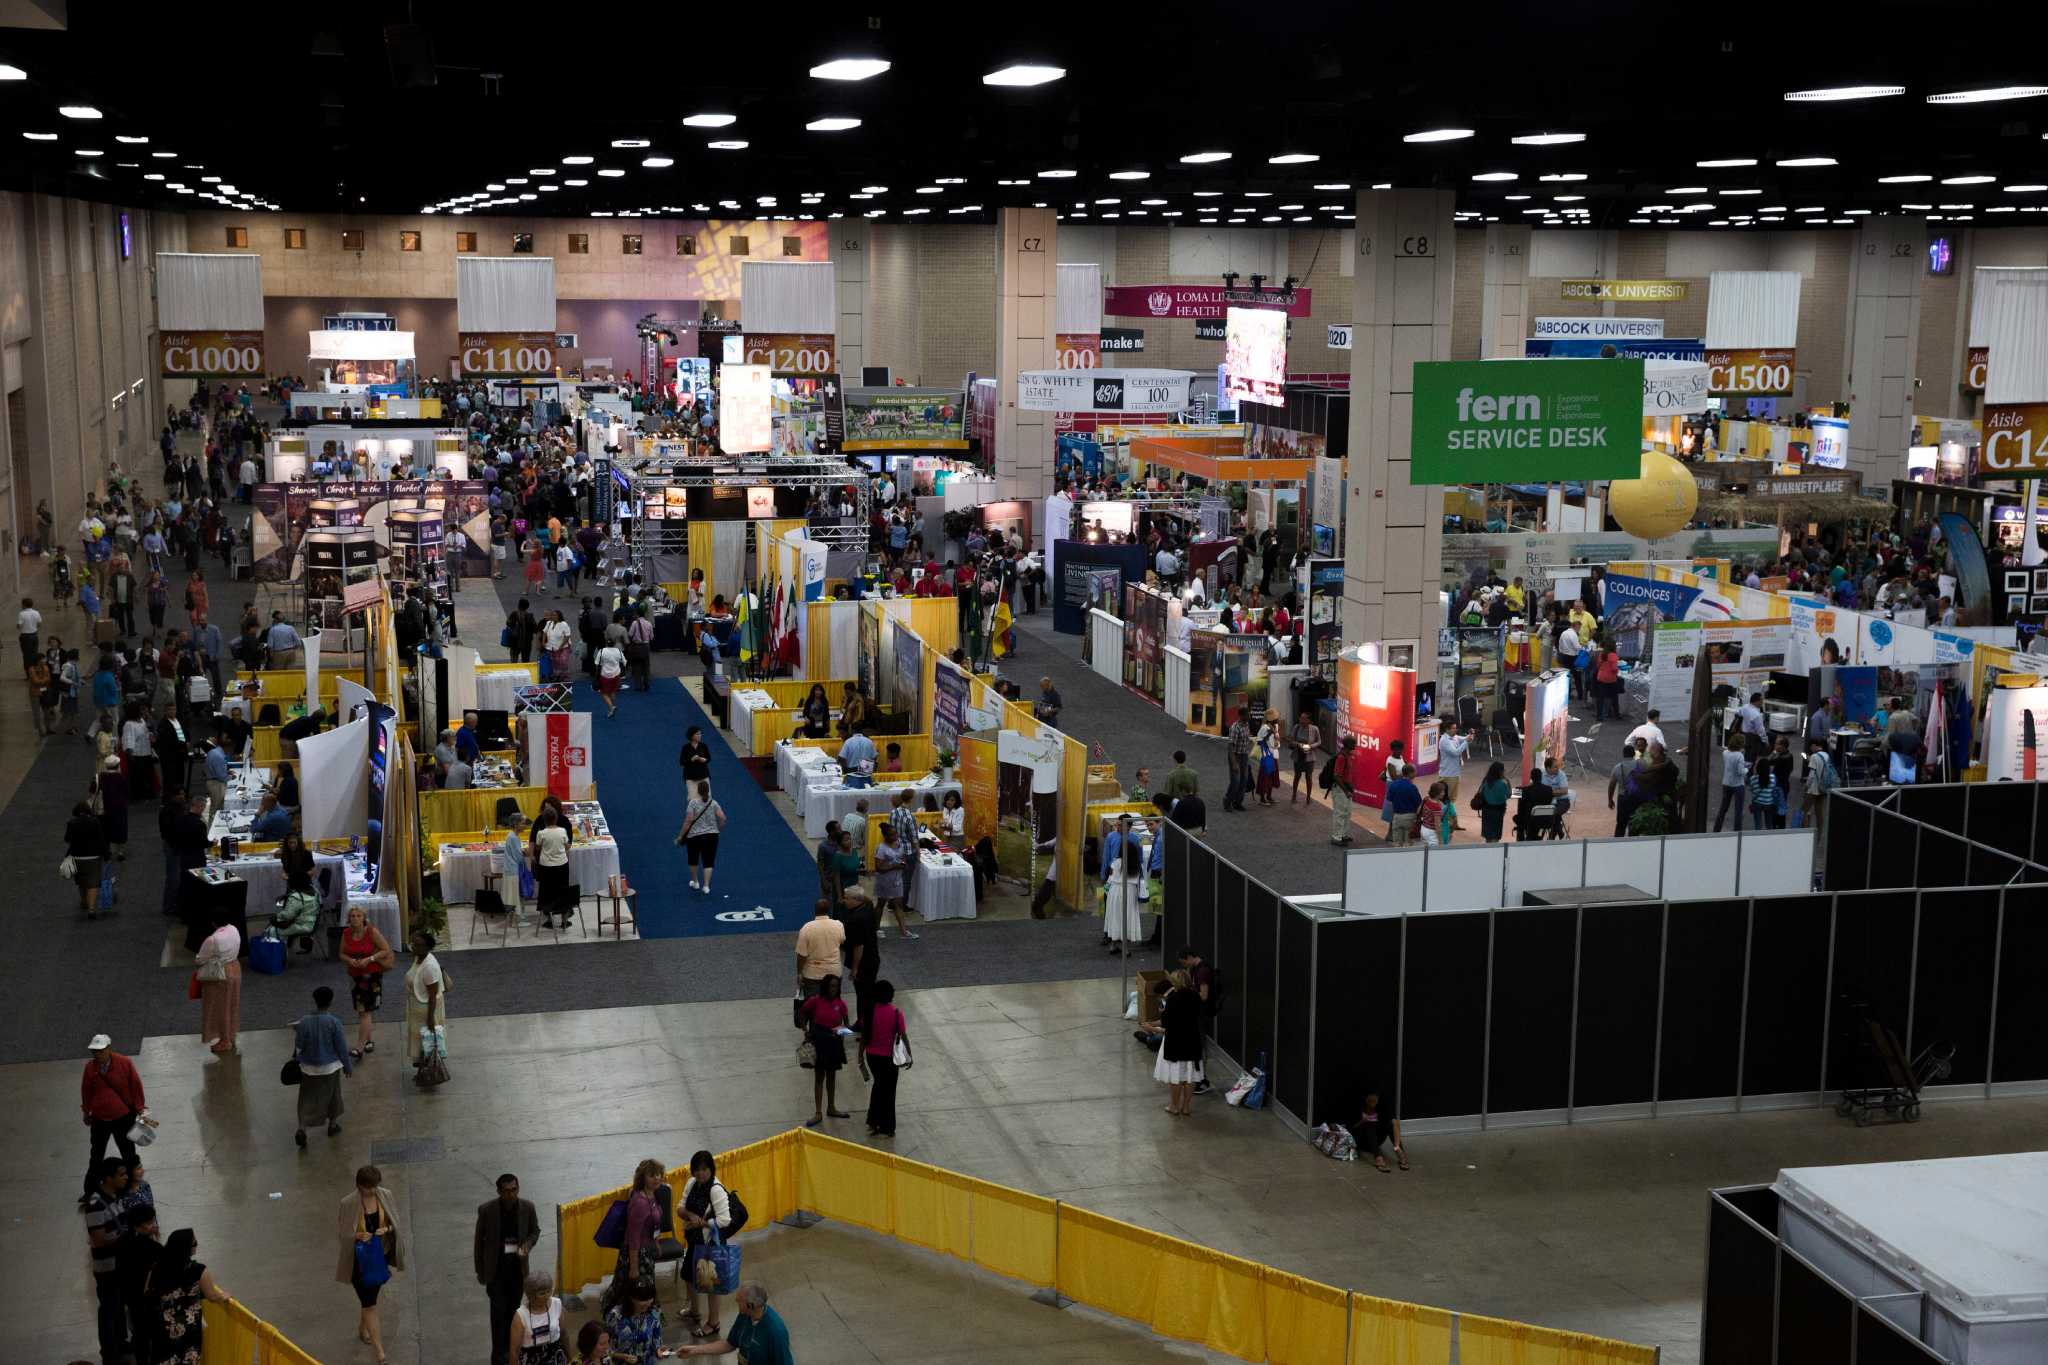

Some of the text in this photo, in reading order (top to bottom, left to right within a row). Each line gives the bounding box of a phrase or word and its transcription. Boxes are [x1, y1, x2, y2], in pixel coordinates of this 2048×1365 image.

[1023, 238, 1041, 250] C7
[1403, 237, 1428, 255] C8
[1177, 292, 1209, 302] LOMA
[1177, 306, 1220, 317] HEALTH
[374, 320, 392, 331] TV
[1537, 322, 1590, 335] BABCOCK
[165, 335, 190, 346] Aisle
[463, 336, 487, 347] Aisle
[747, 338, 770, 347] Aisle
[1101, 336, 1132, 349] make
[1328, 330, 1346, 346] 020
[165, 346, 260, 372] C1000
[463, 347, 552, 372] C1100
[747, 348, 830, 373] C1200
[1708, 354, 1730, 365] Aisle
[1043, 376, 1082, 387] WHITE
[1708, 364, 1790, 392] C1500
[1148, 387, 1168, 403] 100
[1657, 390, 1687, 409] ONE
[1456, 387, 1541, 422] fern
[1987, 411, 2024, 428] Aisle
[1447, 427, 1608, 449] SERVICE DESK
[288, 485, 318, 497] Sharing
[1772, 480, 1844, 494] MARKETPLACE
[1609, 581, 1671, 603] COLLONGES
[550, 735, 560, 777] POLSKA
